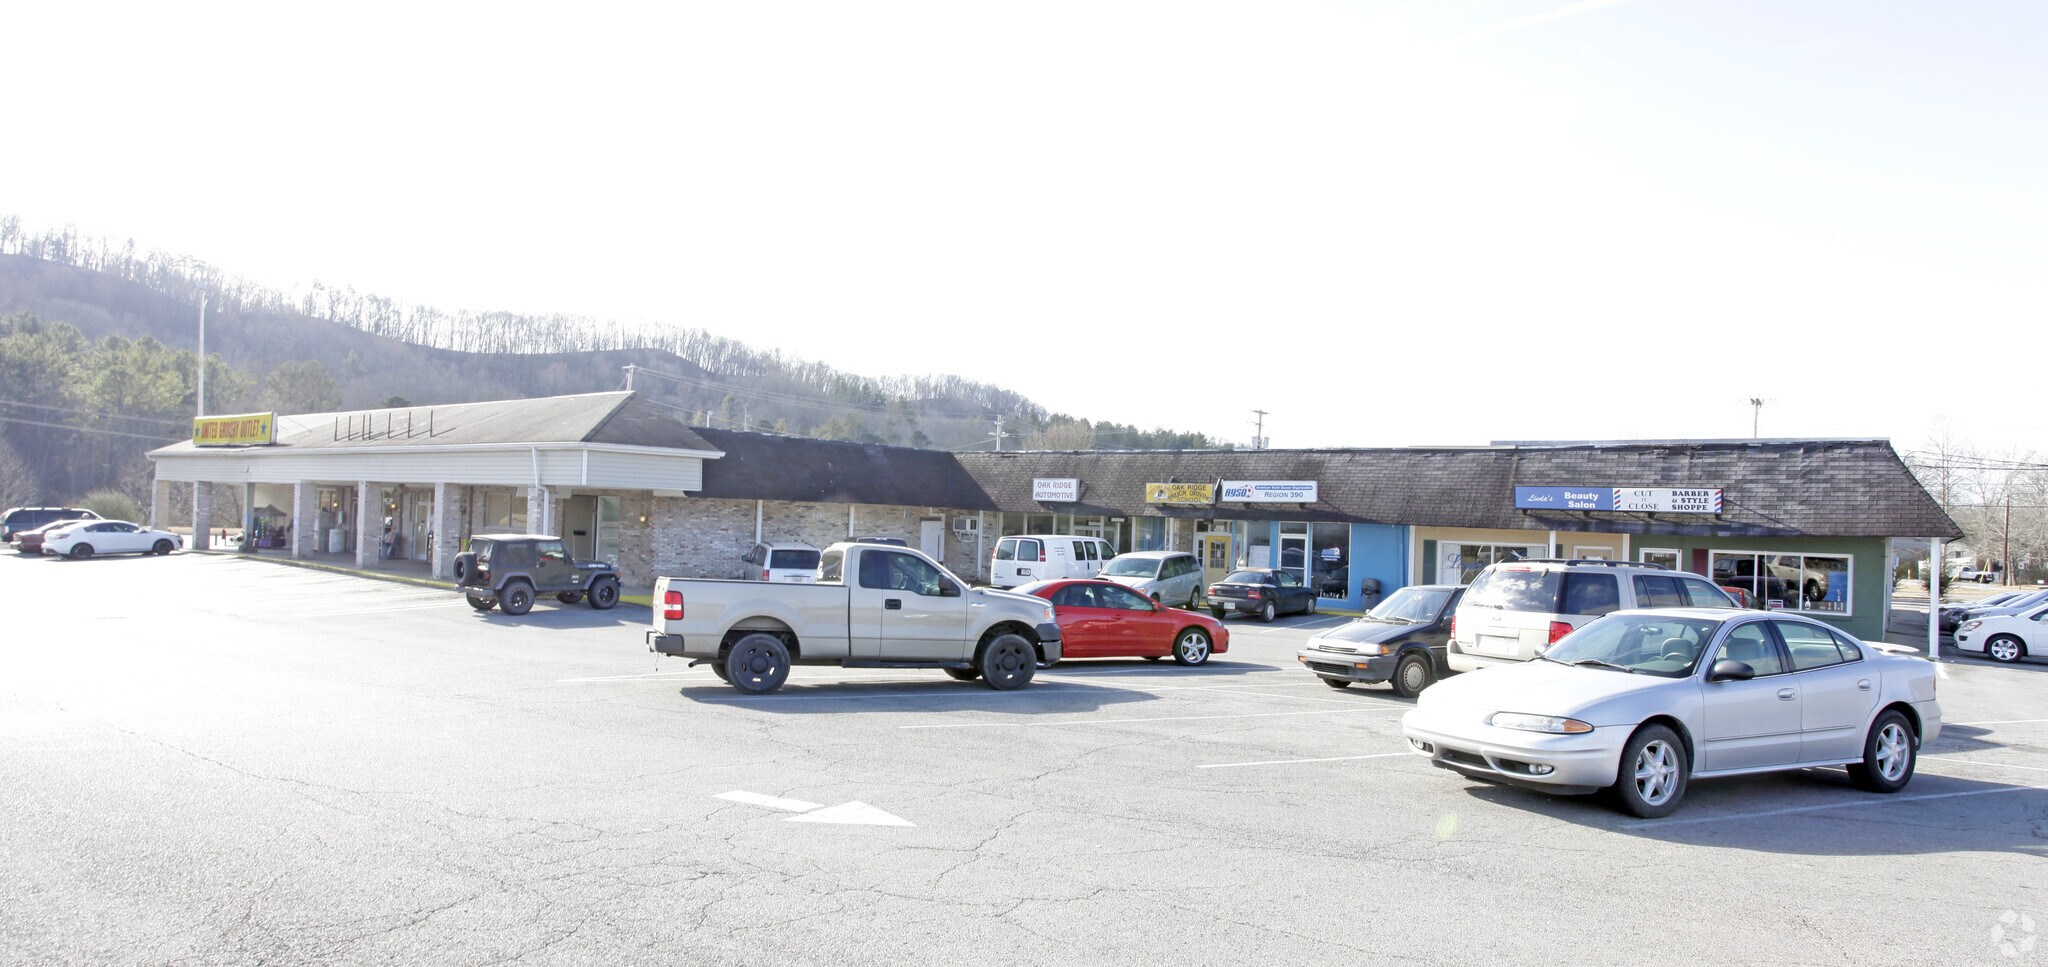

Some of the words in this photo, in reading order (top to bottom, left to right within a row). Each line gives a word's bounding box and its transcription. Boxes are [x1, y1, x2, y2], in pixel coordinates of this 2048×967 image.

[202, 422, 218, 439] UNITED
[219, 420, 240, 438] GROCERY
[240, 419, 260, 438] OUTLET
[1168, 490, 1187, 501] TRUCK
[1189, 491, 1213, 502] DRIVING
[1225, 488, 1247, 497] AYSO
[1564, 491, 1599, 502] Beauty
[1527, 494, 1554, 502] Linda's
[1568, 501, 1596, 509] Salon
[1628, 502, 1660, 510] CLOSE
